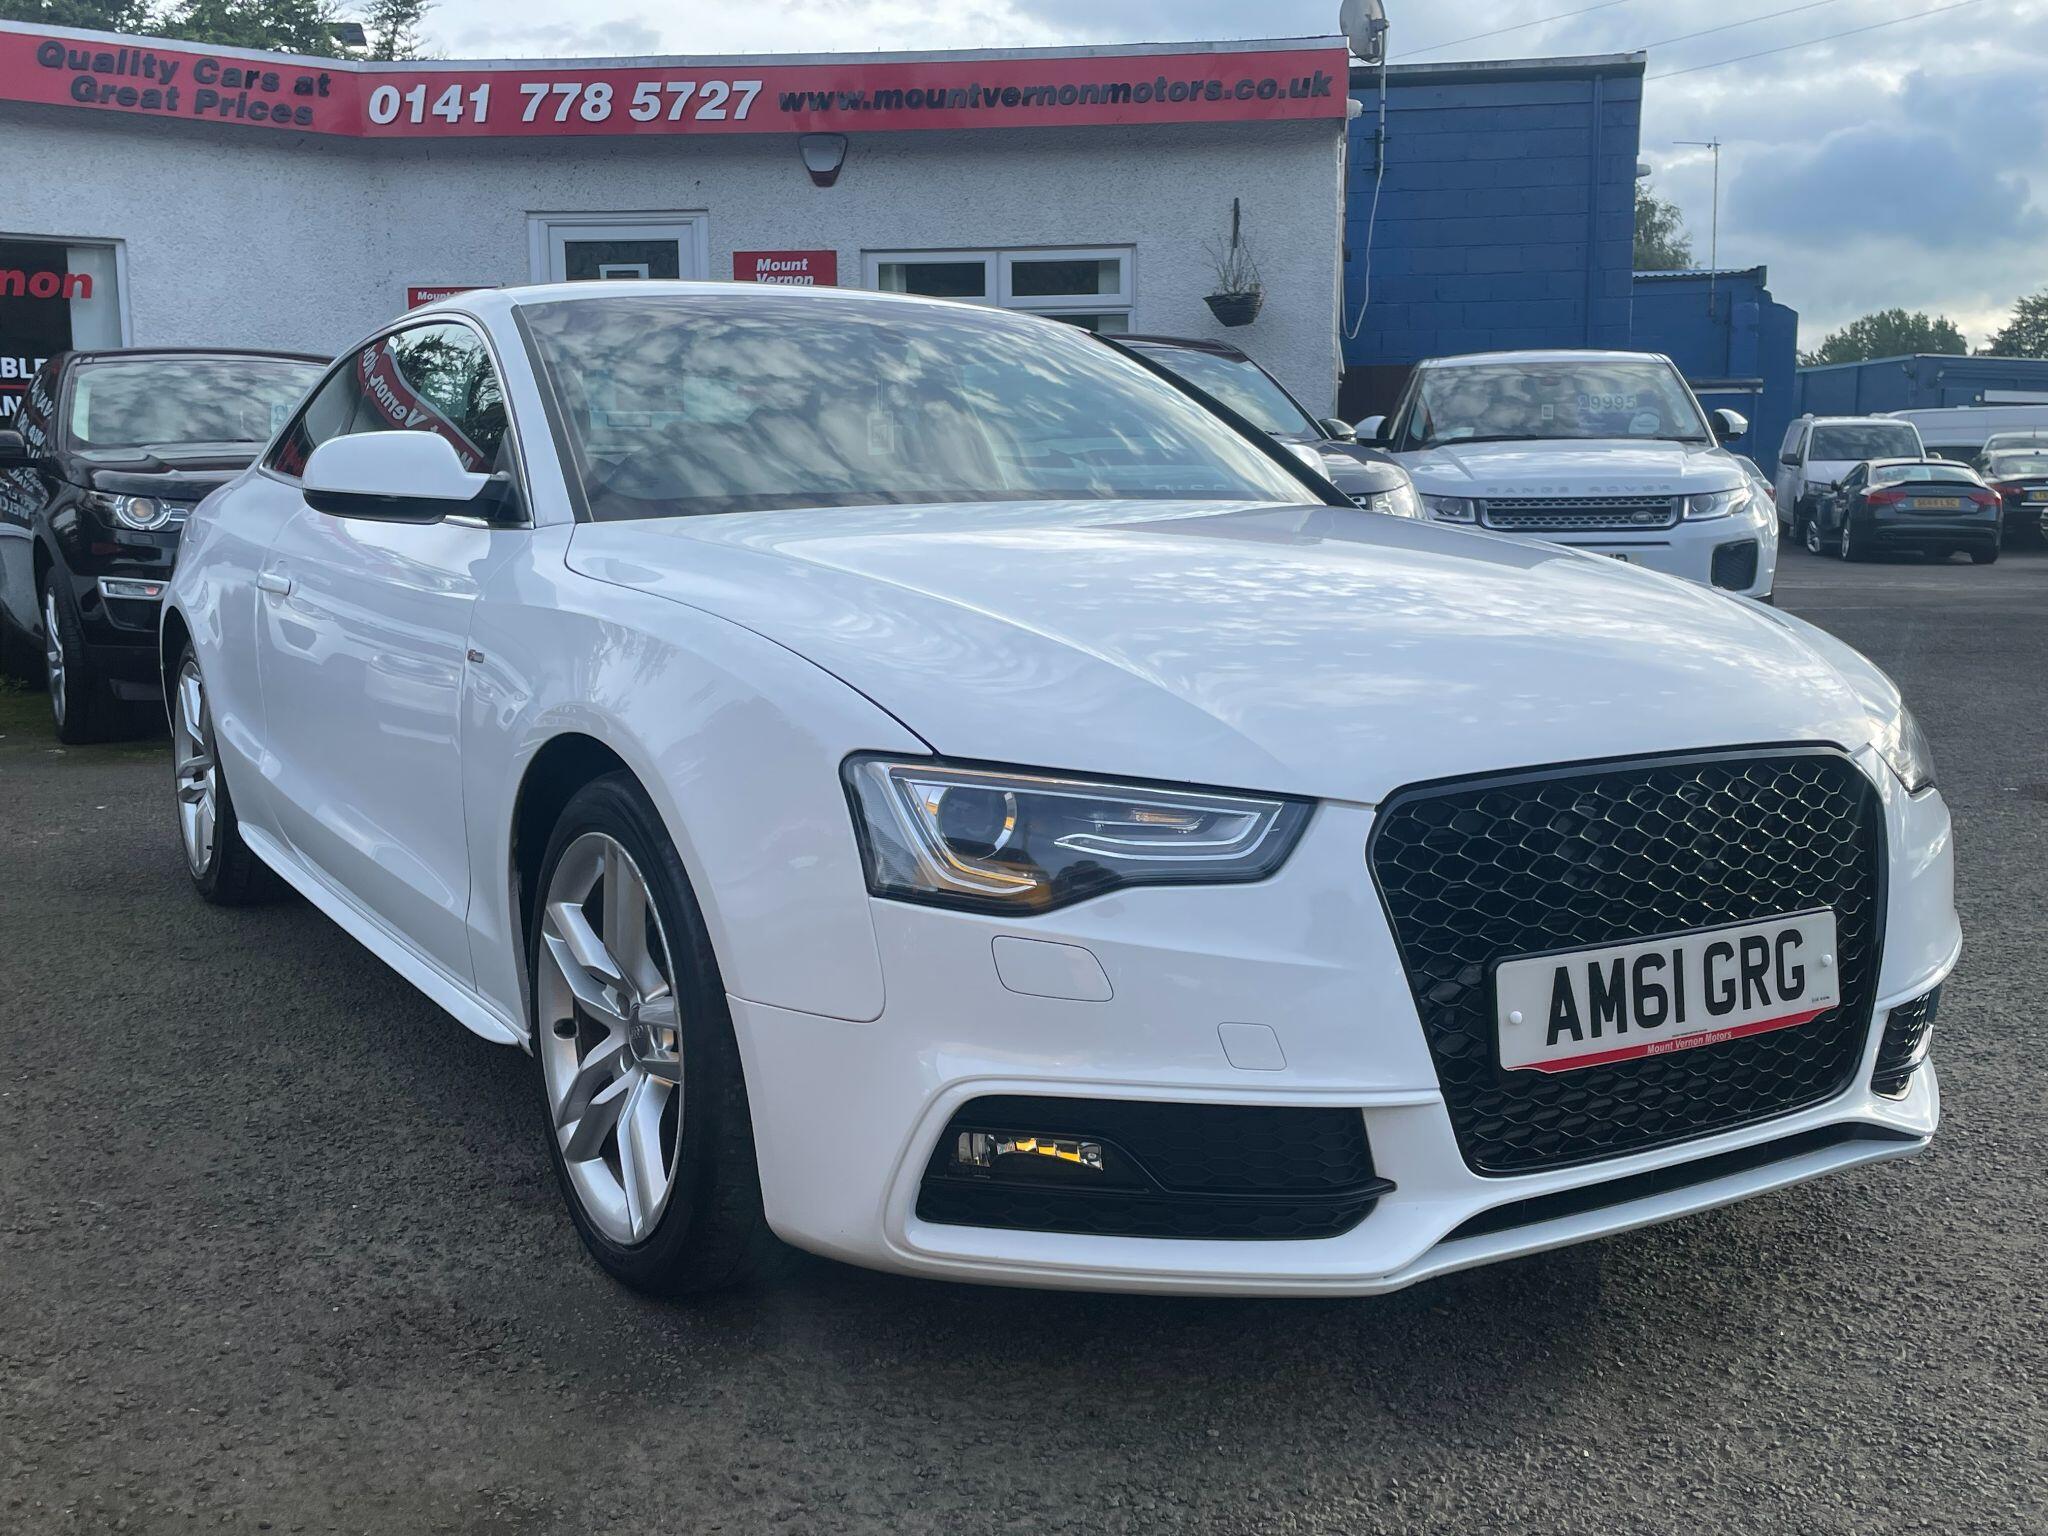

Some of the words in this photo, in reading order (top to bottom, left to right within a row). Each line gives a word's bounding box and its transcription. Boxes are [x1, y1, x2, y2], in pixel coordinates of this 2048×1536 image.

[36, 40, 180, 84] Quality
[193, 58, 281, 93] Cars
[293, 73, 331, 97] at
[70, 75, 180, 111] Great
[194, 89, 313, 126] Prices
[368, 84, 490, 124] 0141
[519, 82, 613, 123] 778
[629, 80, 763, 122] 5727
[778, 70, 1334, 112] www.mountvernonmotors.co.uk
[756, 258, 808, 272] Mount
[756, 272, 814, 286] Vernon
[1486, 486, 1570, 494] RANGE
[1588, 484, 1672, 493] ROVER
[1546, 948, 1686, 1046] AM61
[1703, 928, 1805, 1016] GRG
[1647, 1042, 1673, 1054] Mount
[1675, 1037, 1703, 1048] Vernon
[1705, 1031, 1732, 1043] Motors
